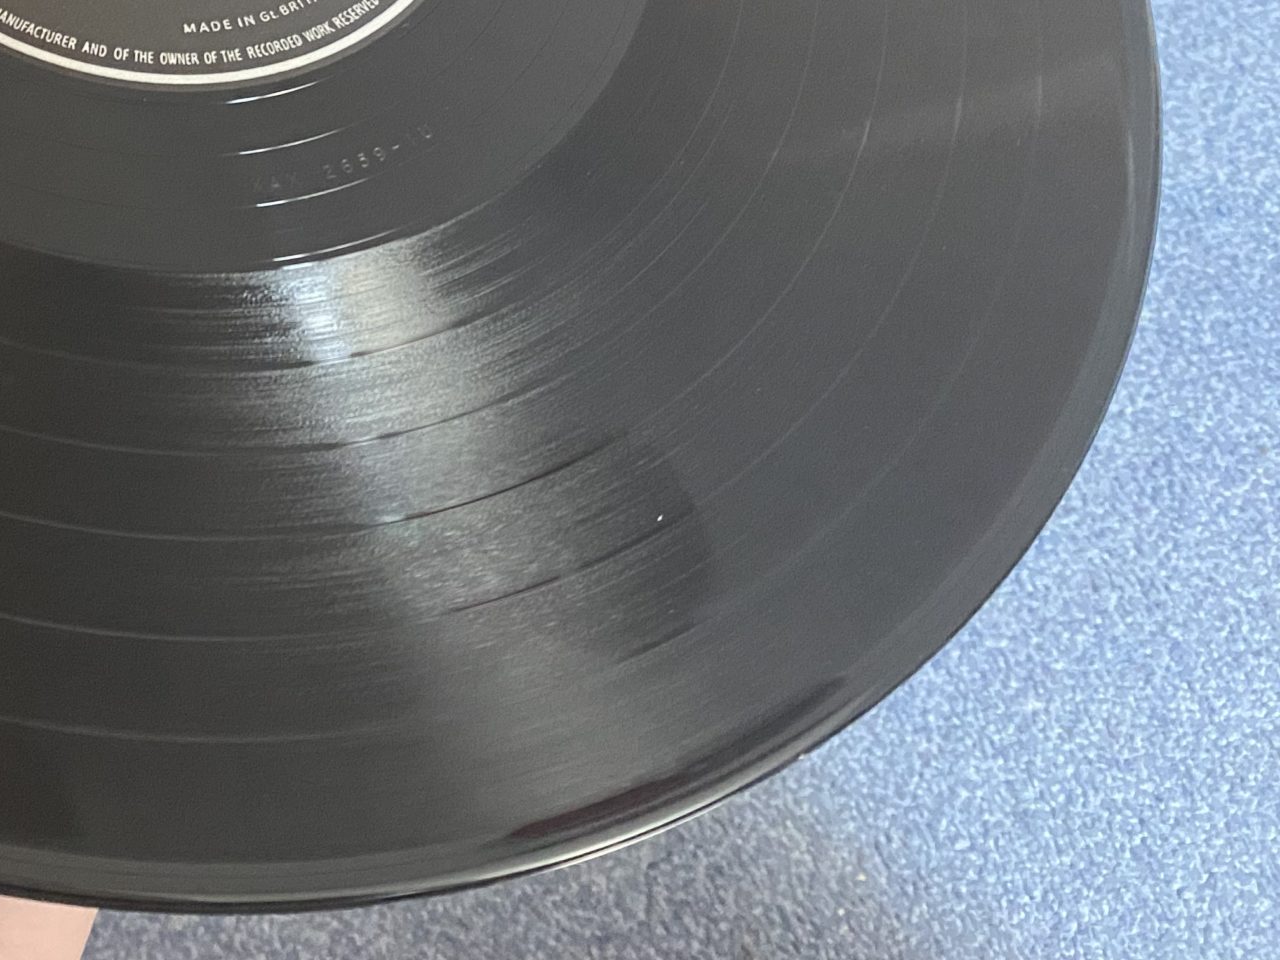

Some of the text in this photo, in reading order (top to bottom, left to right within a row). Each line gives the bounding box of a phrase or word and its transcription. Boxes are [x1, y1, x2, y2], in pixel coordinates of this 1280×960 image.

[183, 19, 233, 34] MADE
[237, 15, 256, 28] IN
[81, 41, 108, 57] AND
[113, 47, 130, 61] OF
[133, 49, 154, 64] THE
[160, 51, 200, 66] OWNER
[204, 50, 220, 65] OF
[221, 47, 242, 63] THE
[246, 34, 303, 59] RECORDED
[302, 22, 336, 43] WORK
